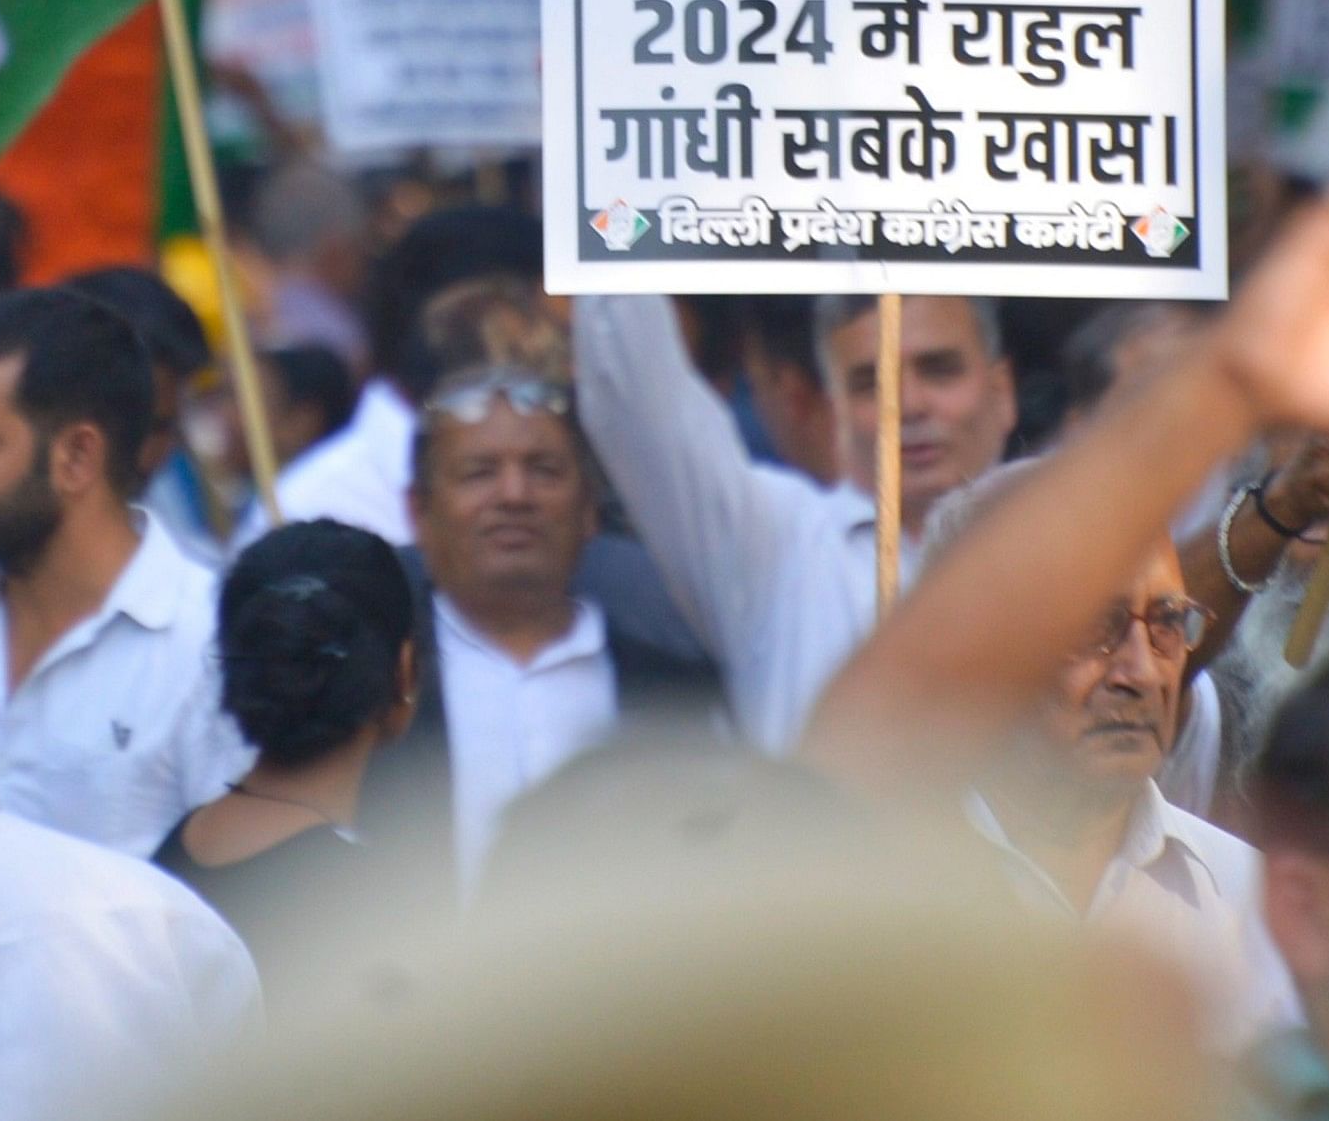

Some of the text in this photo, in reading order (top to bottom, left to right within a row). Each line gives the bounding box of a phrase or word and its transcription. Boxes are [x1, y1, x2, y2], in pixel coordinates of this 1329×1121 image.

[942, 2, 1143, 88] राहुल
[599, 82, 761, 179] गांधी
[774, 84, 963, 180] सबके
[657, 195, 1127, 255] दिल्ली प्रदेश कांग्रेस कमेटी
